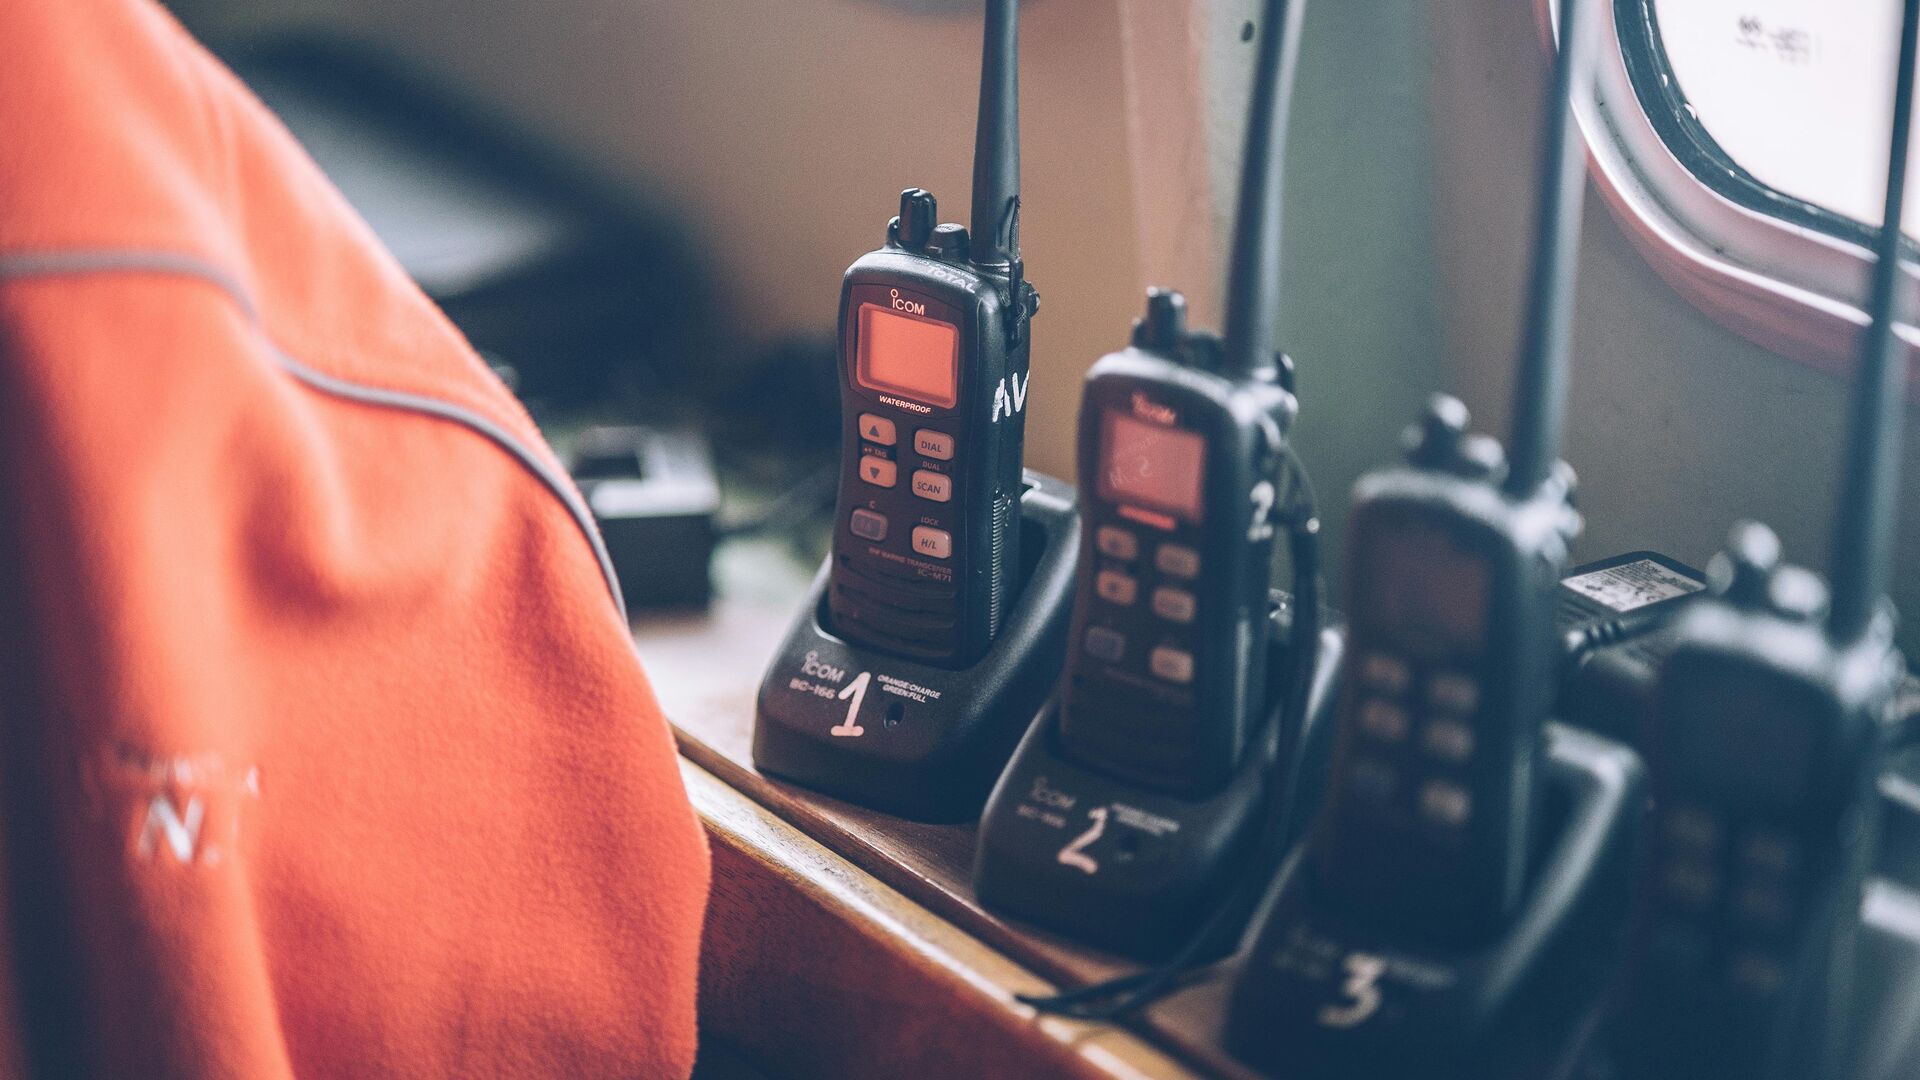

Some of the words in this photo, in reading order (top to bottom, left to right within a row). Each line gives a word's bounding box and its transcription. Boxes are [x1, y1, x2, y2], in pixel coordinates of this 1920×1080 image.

[879, 395, 932, 415] WATERPROOF
[991, 369, 1030, 423] AV
[920, 440, 943, 453] DIAL
[922, 460, 941, 471] DUAL
[916, 481, 942, 494] SCAN
[920, 516, 940, 526] LOCK
[1248, 480, 1276, 542] 2
[921, 538, 938, 550] H/L
[830, 671, 872, 737] 1
[1056, 806, 1108, 875] 2
[1318, 952, 1385, 1030] 3
